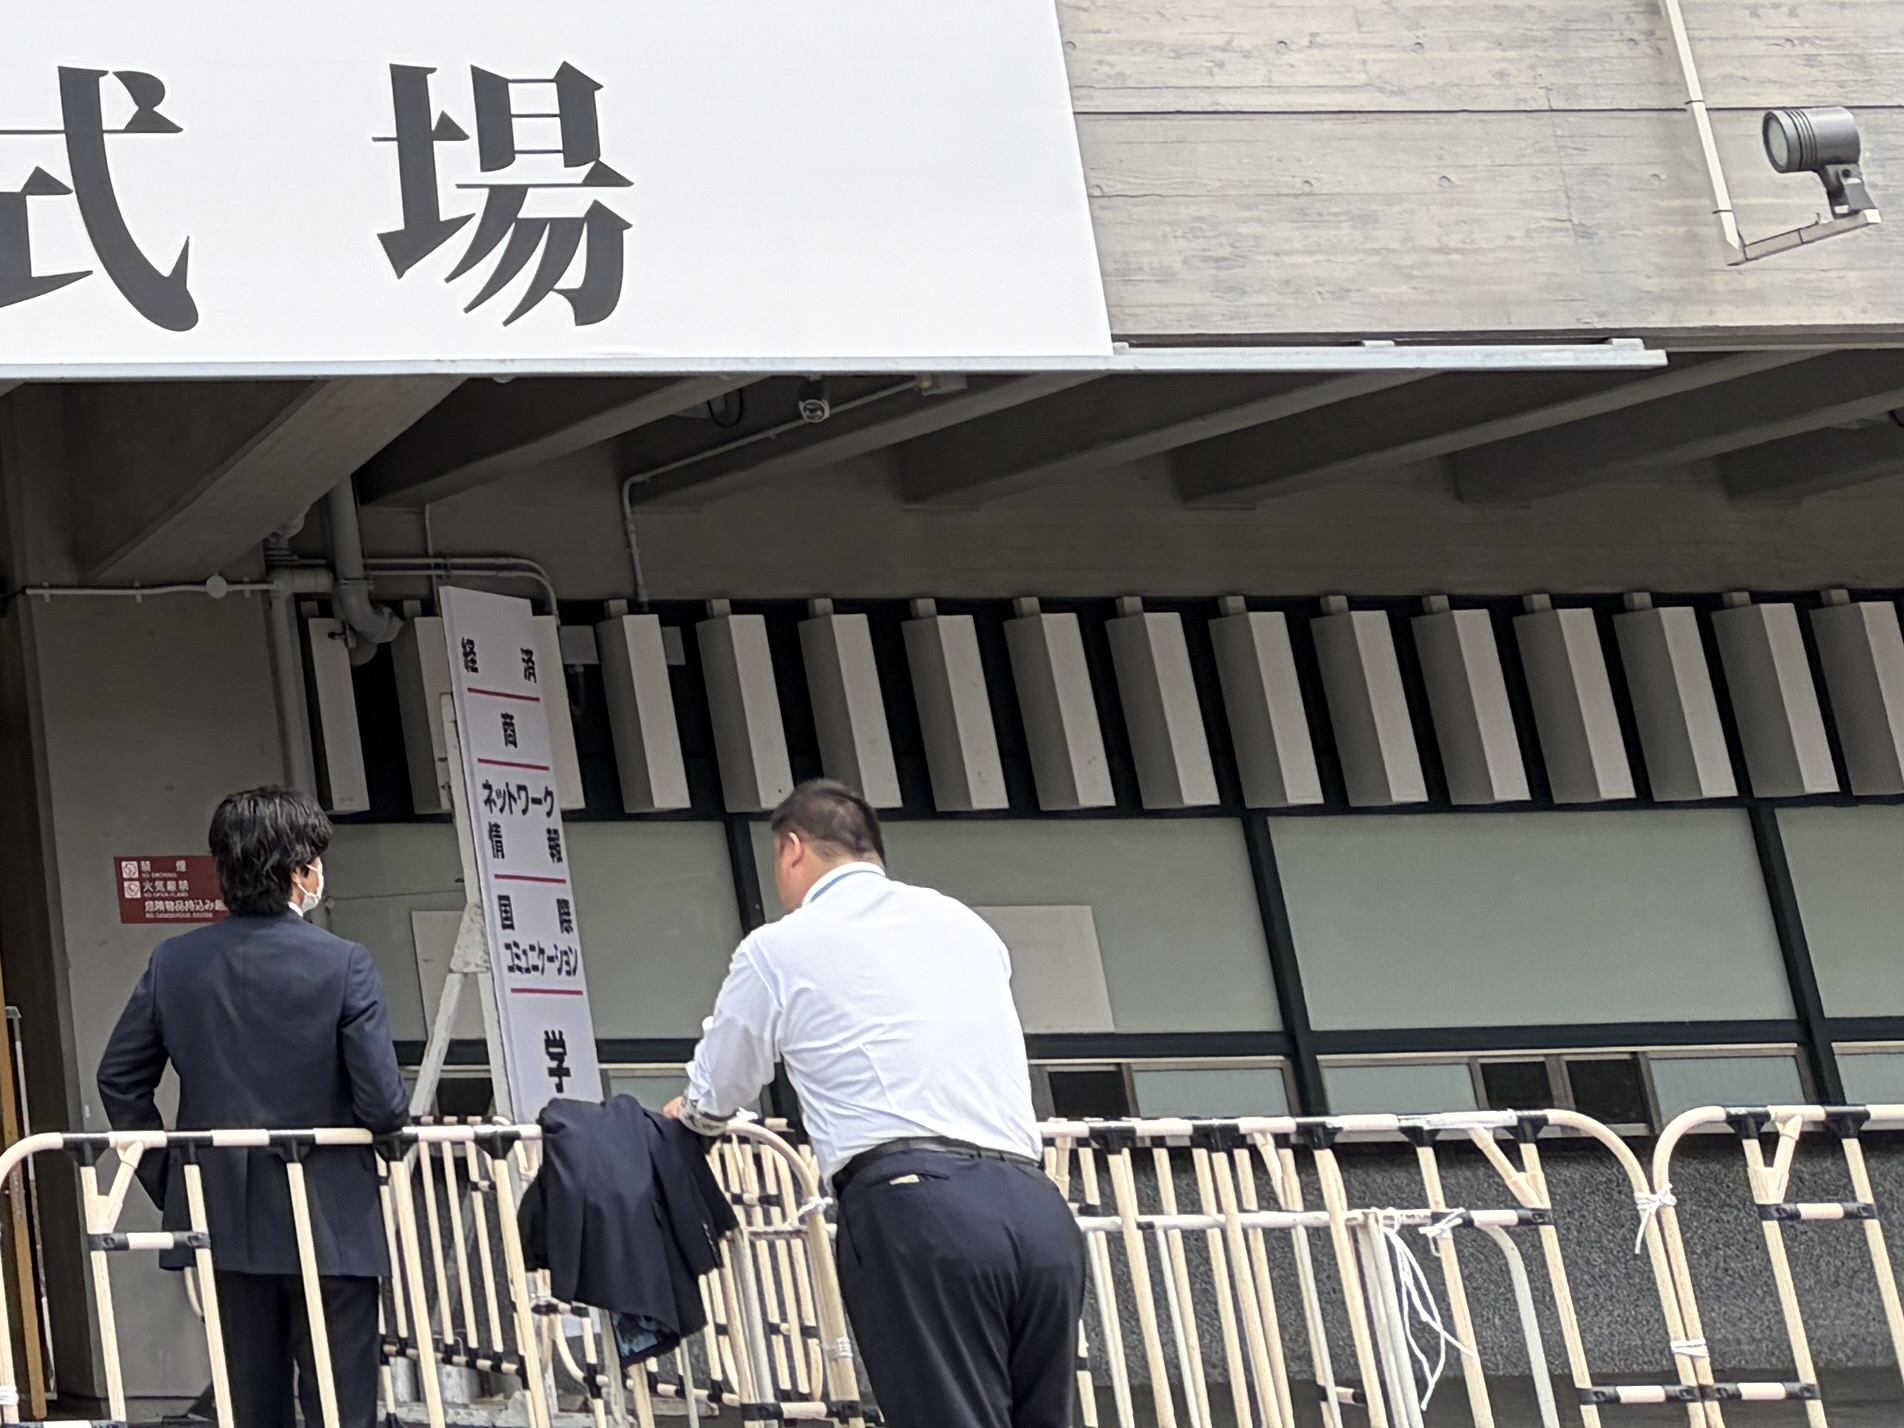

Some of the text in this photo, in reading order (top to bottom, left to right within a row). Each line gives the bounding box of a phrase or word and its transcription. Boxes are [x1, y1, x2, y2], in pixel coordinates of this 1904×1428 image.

[460, 636, 538, 684] 経済
[500, 711, 519, 749] 商
[481, 778, 555, 819] ネットワーク
[487, 820, 564, 864] 情報
[504, 939, 578, 978] コミュニケーション
[543, 1028, 572, 1094] 学
